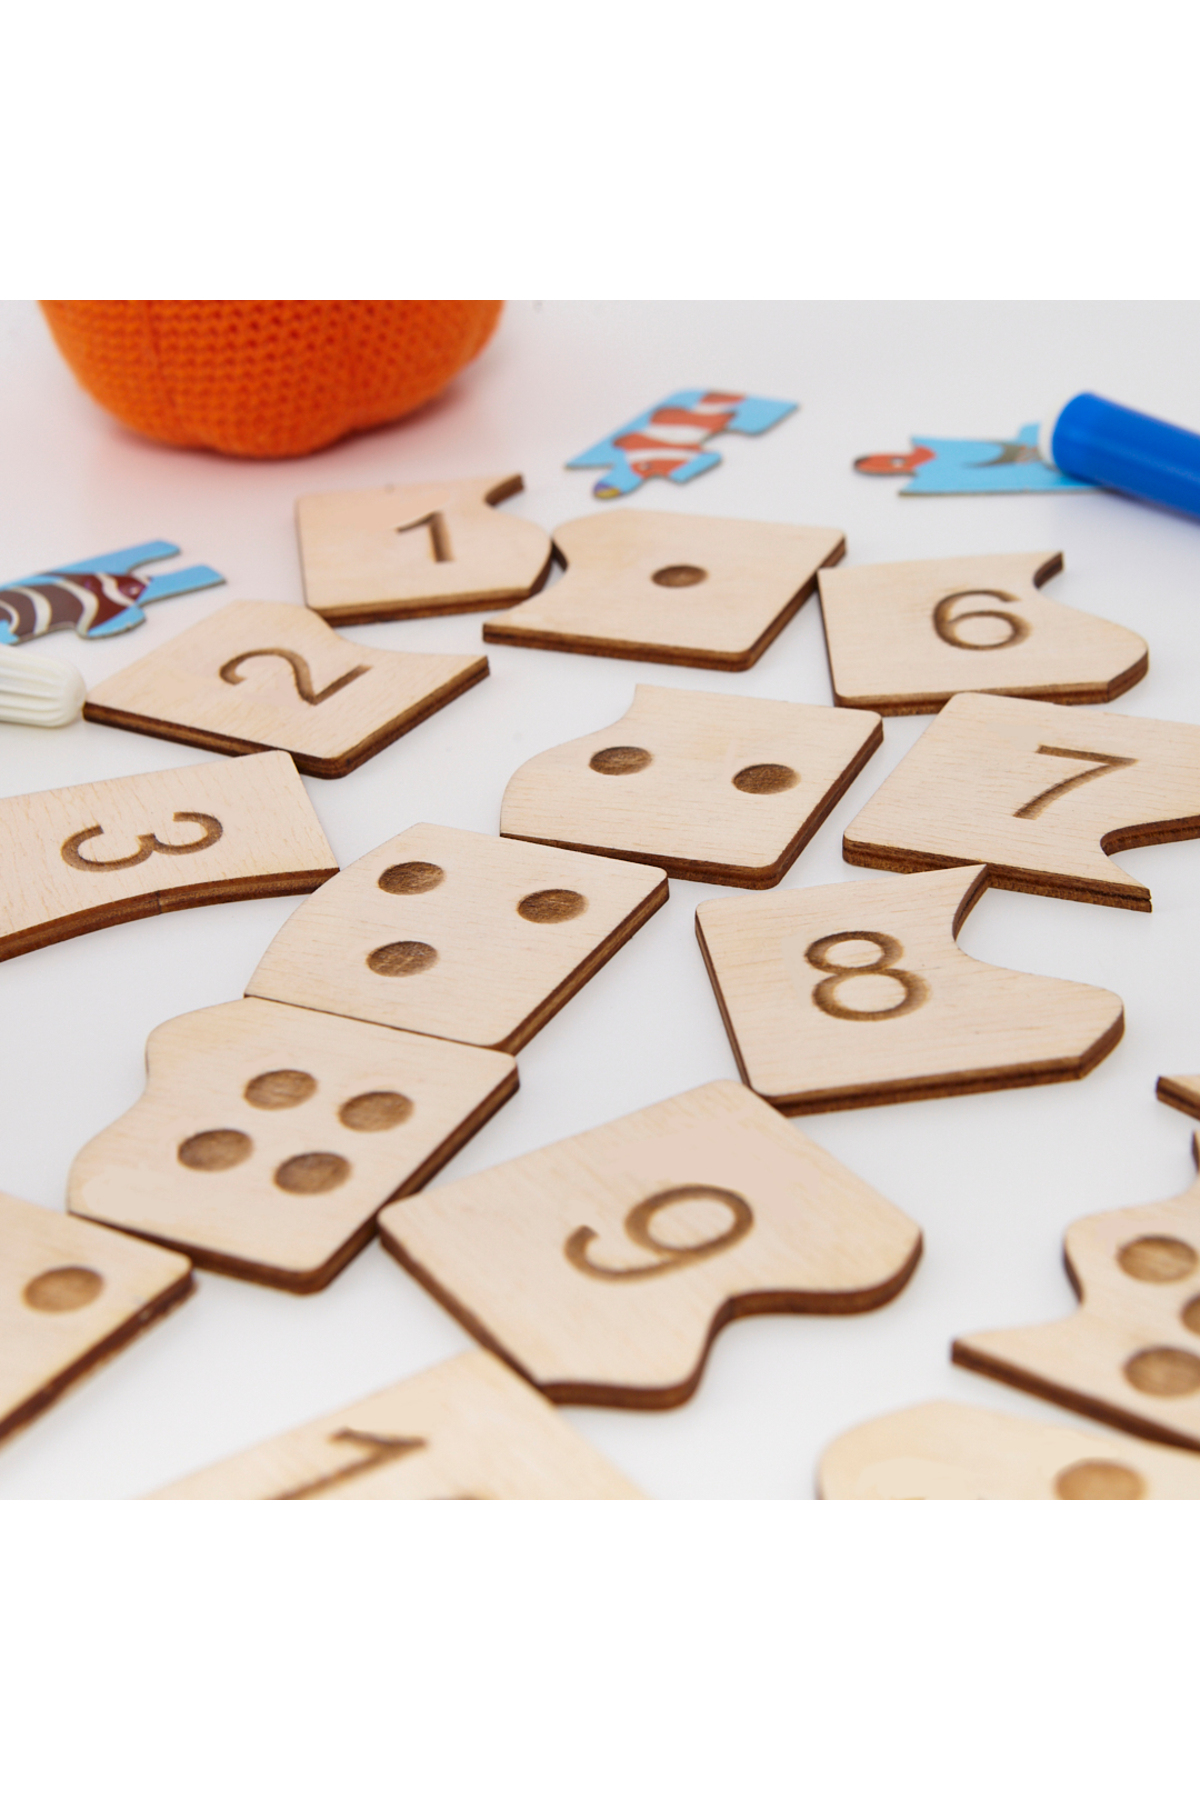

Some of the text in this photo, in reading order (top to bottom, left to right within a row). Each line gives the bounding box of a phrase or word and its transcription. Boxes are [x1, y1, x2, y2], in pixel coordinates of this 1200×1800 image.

[394, 510, 454, 564] 1
[932, 589, 1032, 651] 6
[219, 648, 372, 706] 2
[1012, 744, 1139, 820] 7
[60, 811, 223, 872] 3
[804, 930, 932, 1022] 8
[562, 1183, 755, 1283] 9
[266, 1426, 485, 1500] 1
